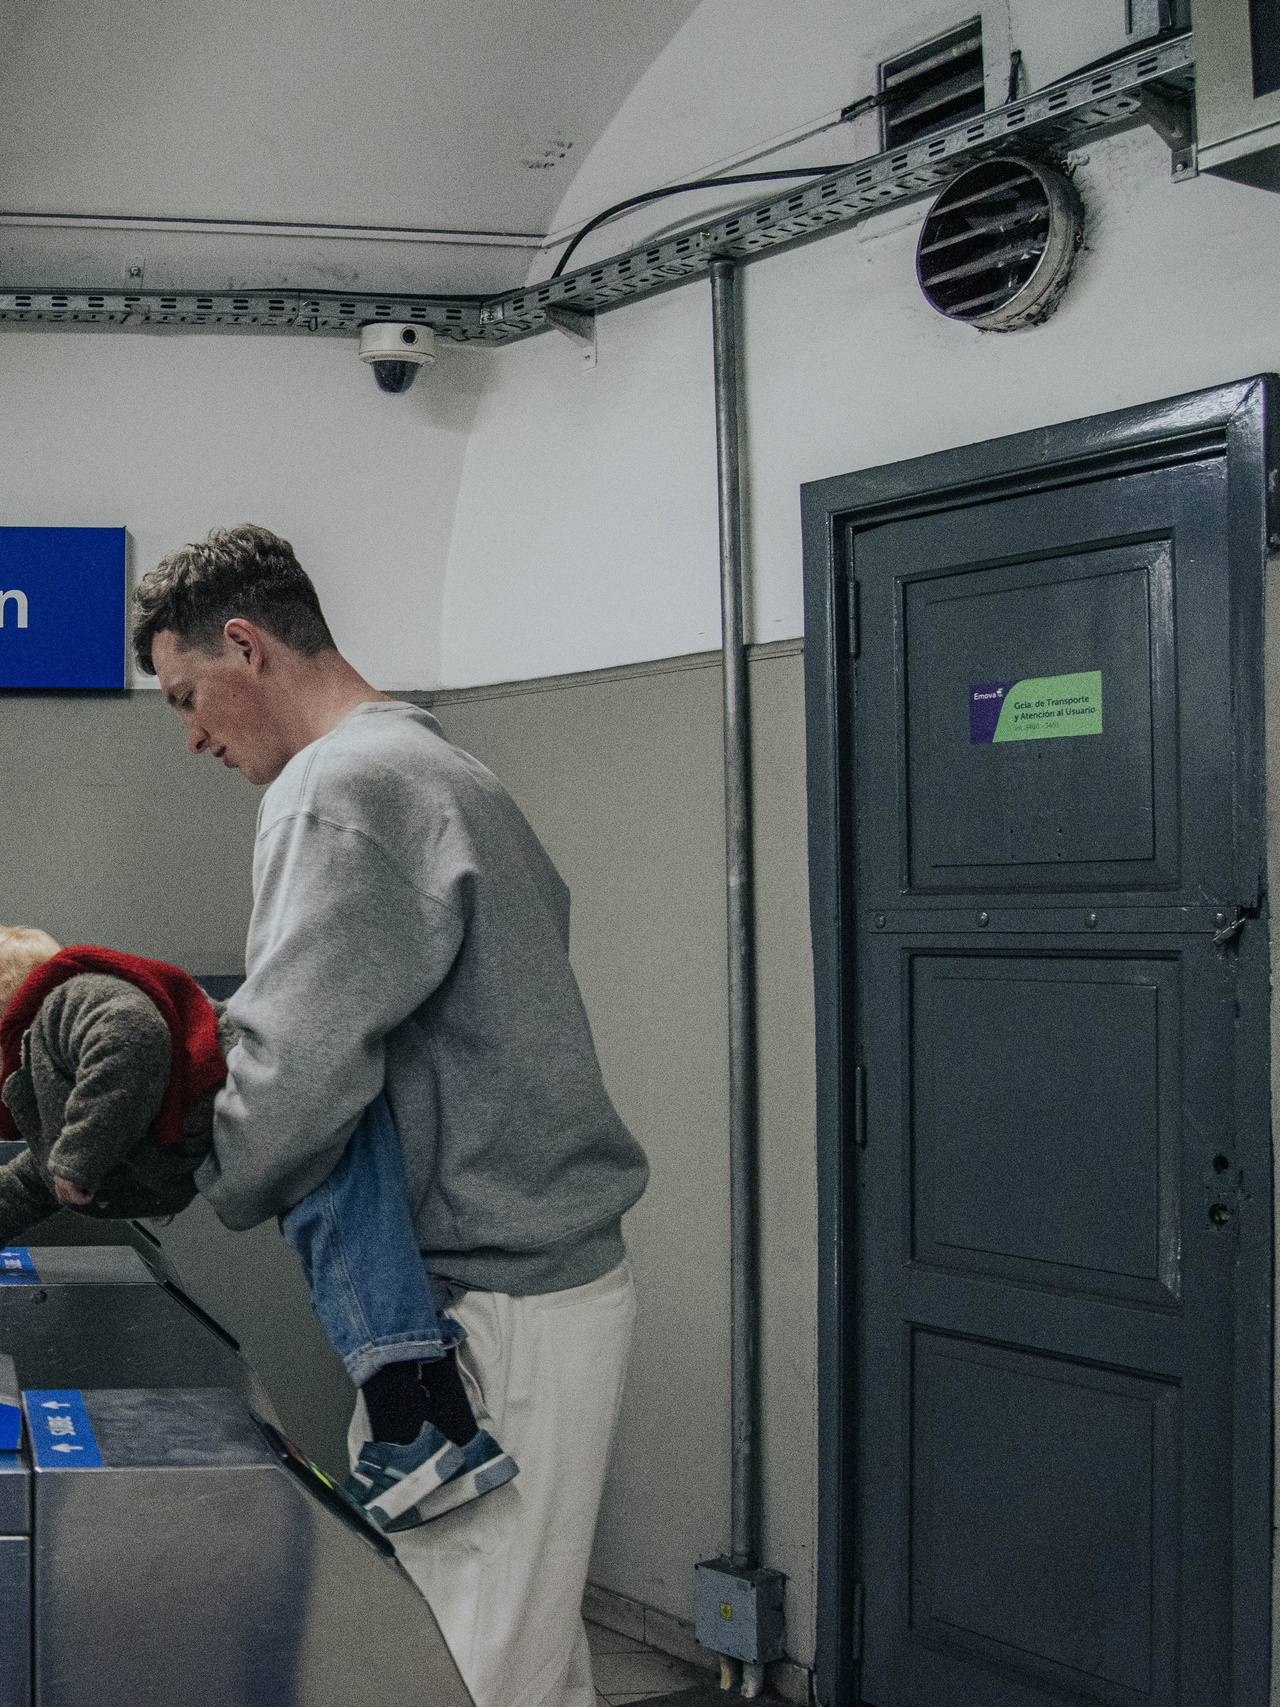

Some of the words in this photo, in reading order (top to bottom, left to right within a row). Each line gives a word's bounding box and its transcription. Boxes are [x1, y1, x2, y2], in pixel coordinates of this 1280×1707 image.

[974, 692, 997, 701] Emova
[1035, 699, 1045, 708] de
[1046, 696, 1090, 707] Transporte
[1014, 714, 1019, 722] y
[1021, 709, 1055, 720] Atención
[1056, 708, 1064, 717] al
[1065, 705, 1096, 716] Usuario
